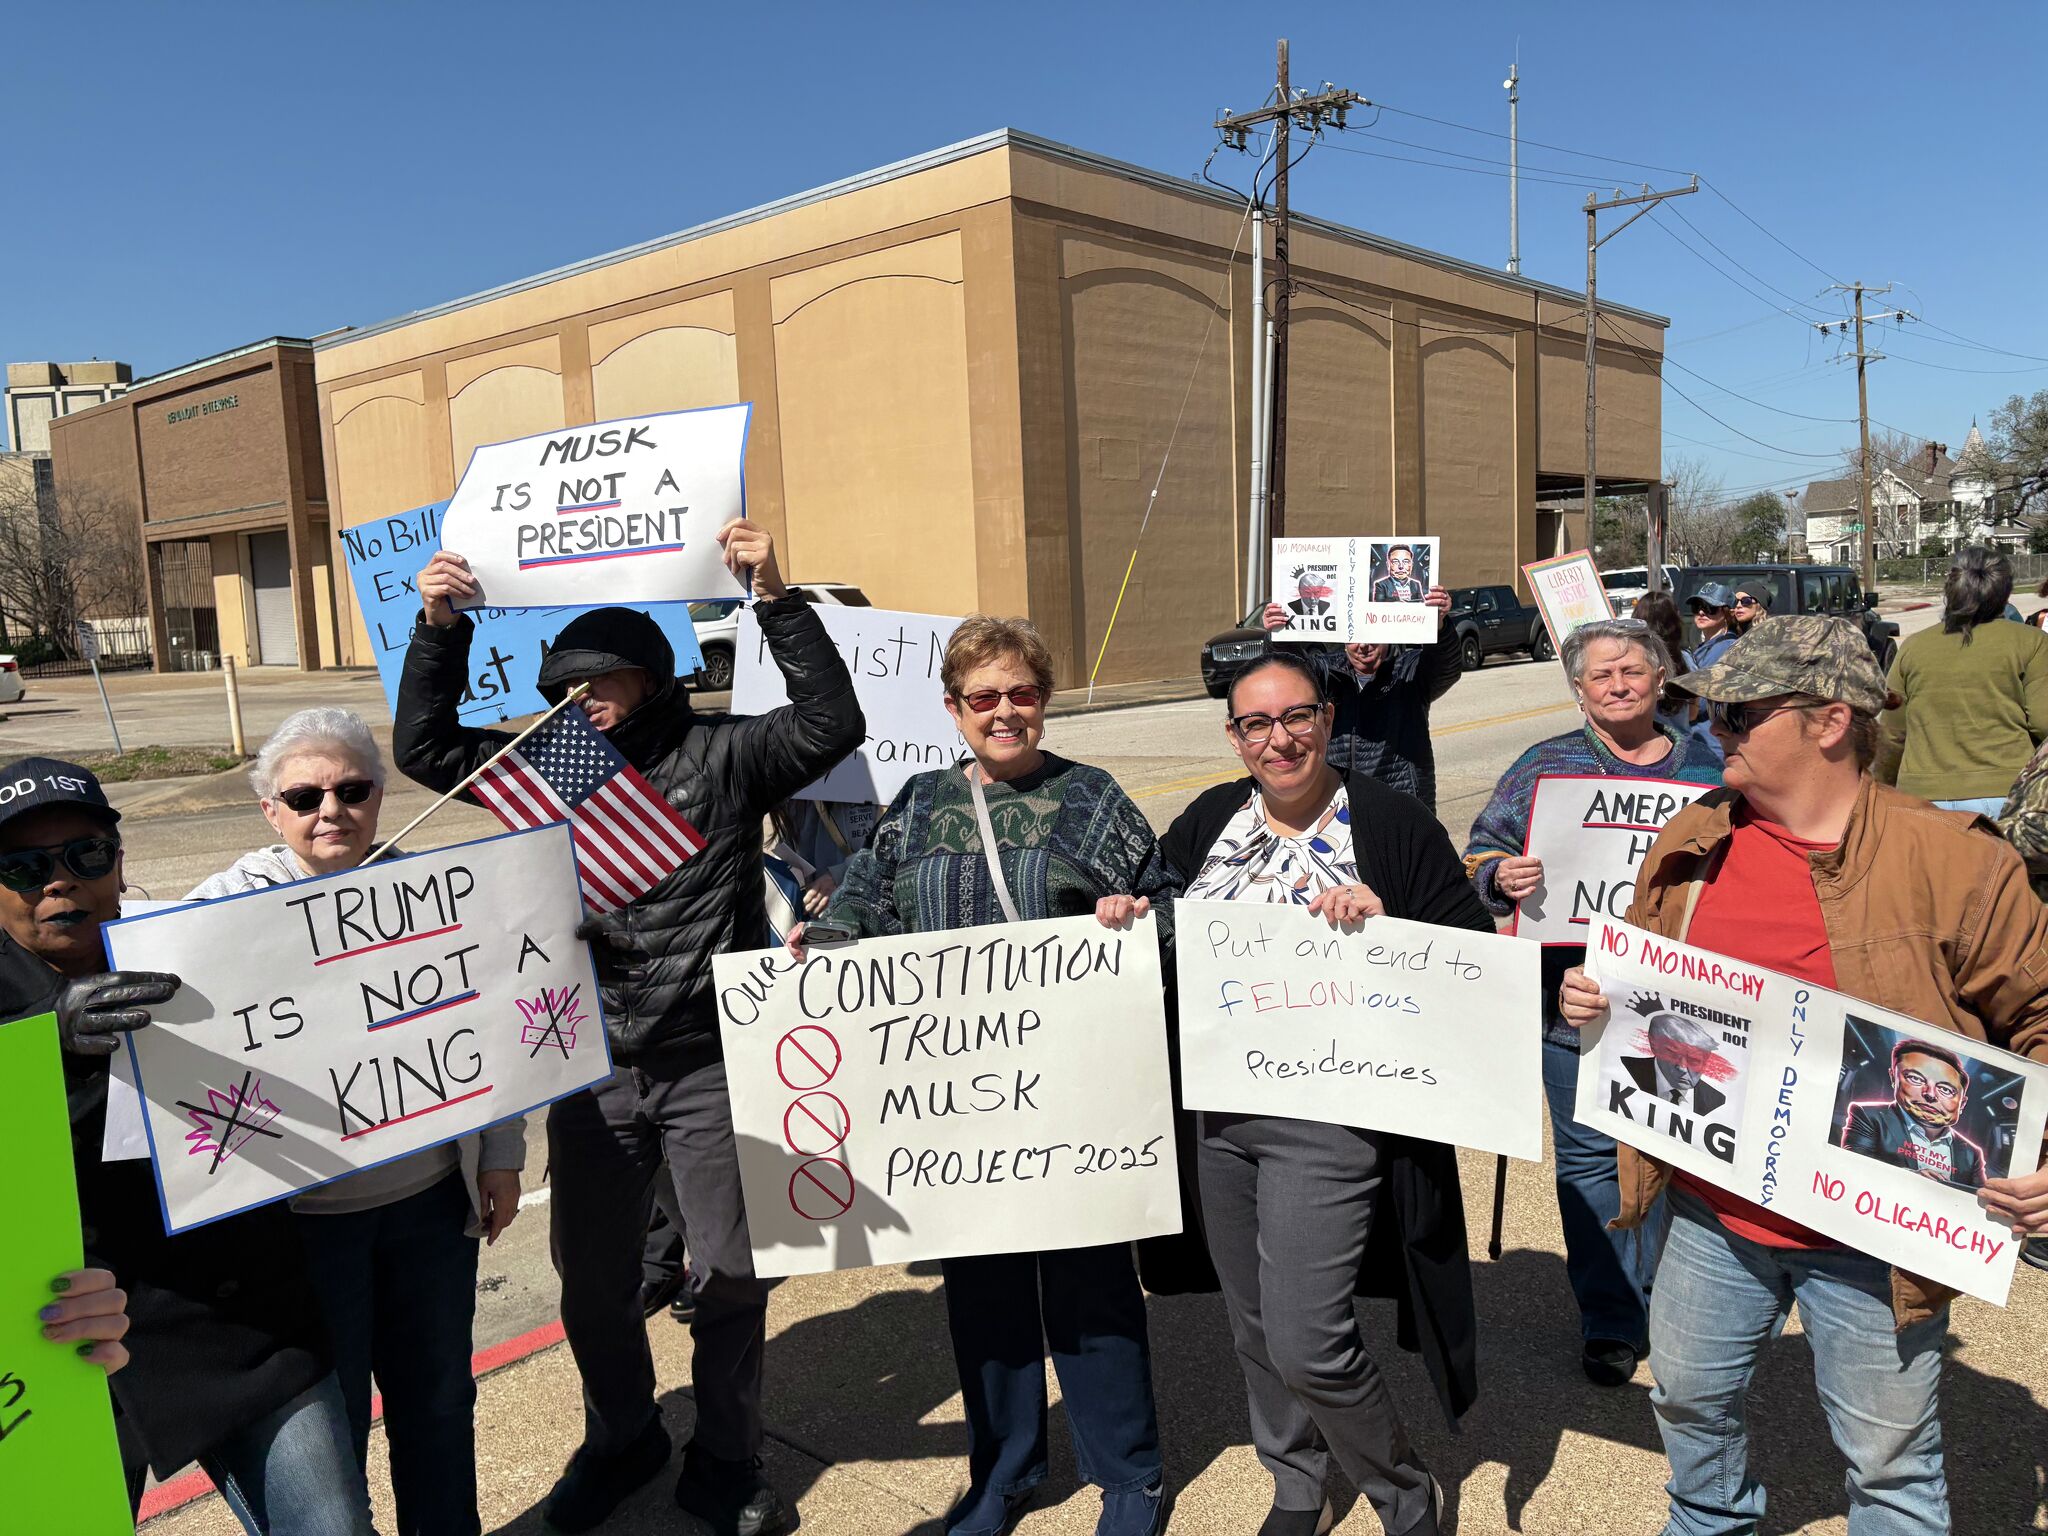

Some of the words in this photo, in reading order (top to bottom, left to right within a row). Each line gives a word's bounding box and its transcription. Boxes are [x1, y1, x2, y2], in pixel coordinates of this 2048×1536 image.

[540, 425, 658, 466] MUSK
[490, 482, 532, 512] IS
[558, 472, 626, 505] NOT
[654, 468, 681, 496] A
[345, 529, 383, 566] No
[387, 508, 443, 552] Bill
[1277, 543, 1287, 554] NO
[1290, 543, 1332, 554] MONARCHY
[1547, 565, 1585, 589] LIBERTY
[1284, 615, 1337, 631] KING
[1365, 612, 1377, 624] NO
[1382, 613, 1426, 624] OLIGARCHY
[44, 775, 87, 794] 1ST
[286, 866, 475, 956] TRUMP
[1207, 920, 1273, 959] Put
[1295, 938, 1342, 961] an
[1366, 940, 1434, 971] end
[1445, 949, 1482, 981] to
[1600, 924, 1629, 957] NO
[1640, 938, 1765, 1002] MONARCHY
[232, 996, 304, 1052] IS
[360, 944, 480, 1023] NOT
[517, 933, 551, 974] A
[720, 956, 800, 1026] OUR
[799, 934, 1122, 1019] CONSTITUTION
[868, 1009, 1041, 1065] TRUMP
[1670, 998, 1752, 1032] PRESIDENT
[1722, 1031, 1748, 1049] not
[1789, 990, 1810, 1056] ONLY
[329, 1029, 482, 1135] KING
[1246, 1038, 1438, 1086] Presidencies
[879, 1069, 1041, 1124] MUSK
[1608, 1079, 1736, 1164] KING
[1760, 1066, 1797, 1206] DEMOCRACY
[1897, 1147, 1958, 1174] PRESIDENT
[1903, 1140, 1927, 1154] NOT
[1929, 1150, 1947, 1162] MY
[886, 1143, 1072, 1196] PROJECT
[1073, 1135, 1164, 1175] 2025
[1812, 1170, 1846, 1201] NO
[1855, 1190, 2004, 1264] OLIGARCHY
